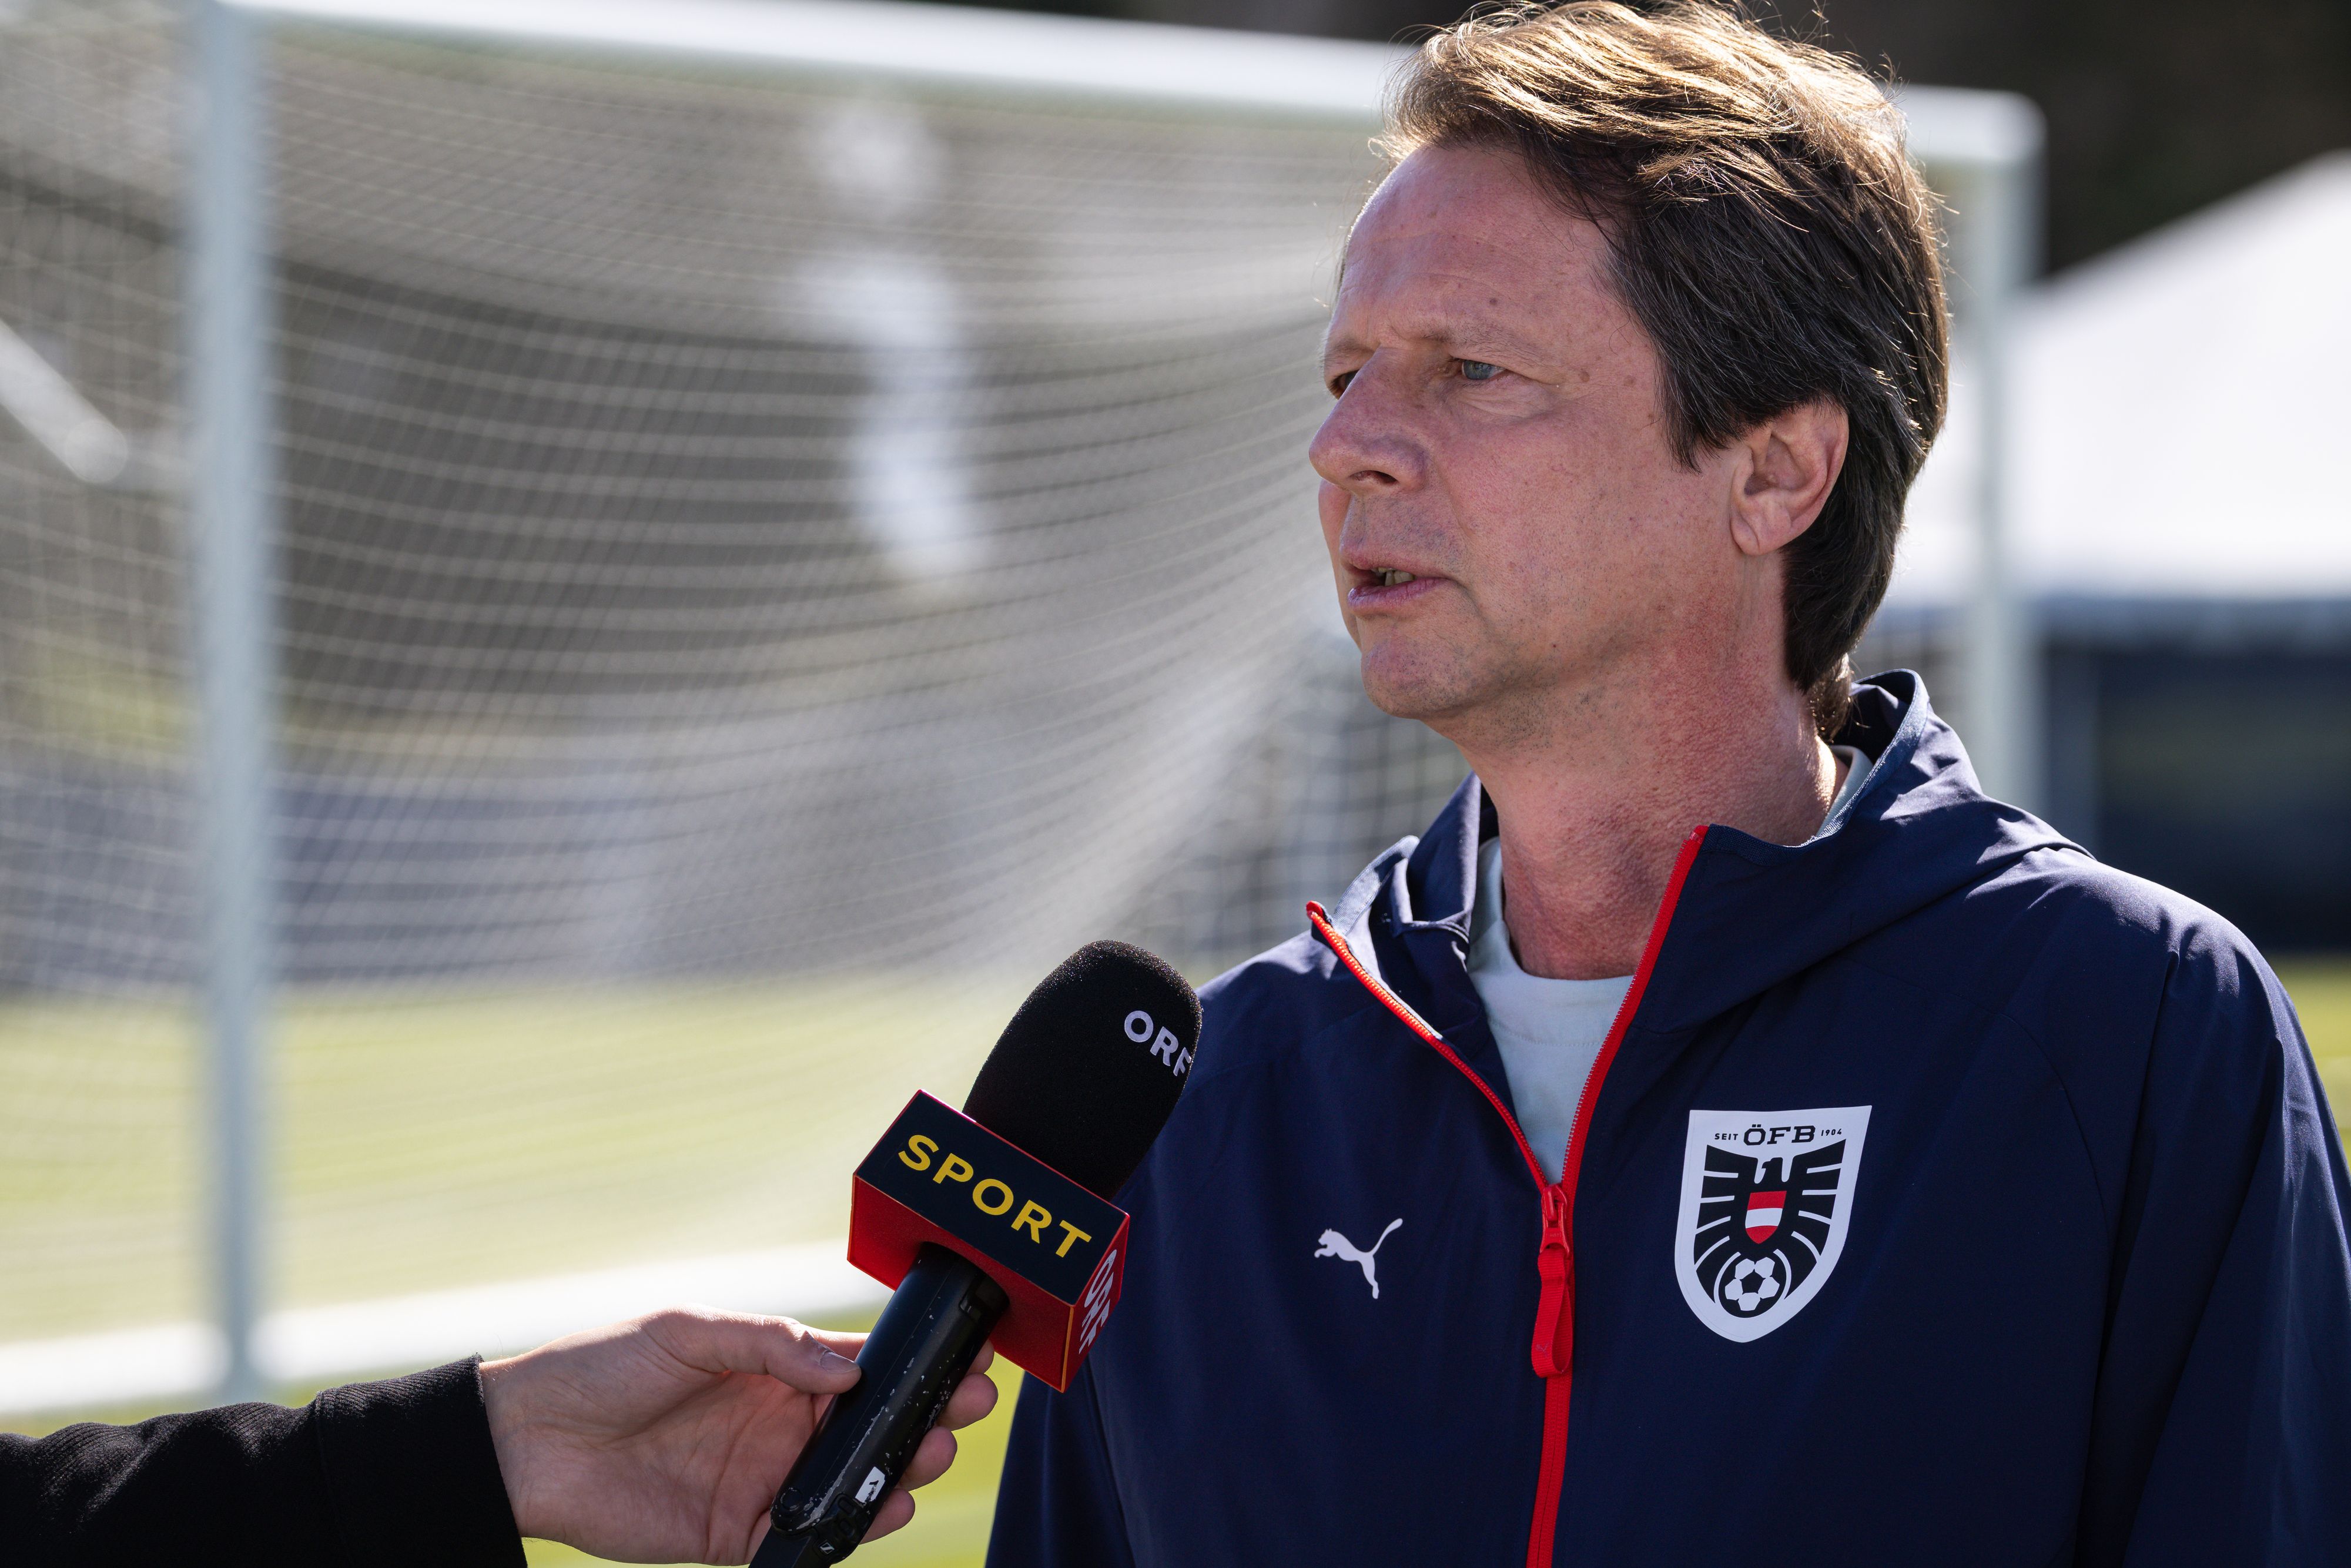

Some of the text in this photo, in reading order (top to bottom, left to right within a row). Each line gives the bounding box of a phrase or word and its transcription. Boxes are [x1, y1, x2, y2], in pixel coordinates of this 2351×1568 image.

[1124, 1010, 1191, 1076] ORF
[1743, 1124, 1816, 1145] ÖFB
[898, 1135, 1091, 1258] SPORT
[1079, 1249, 1117, 1354] ORF
